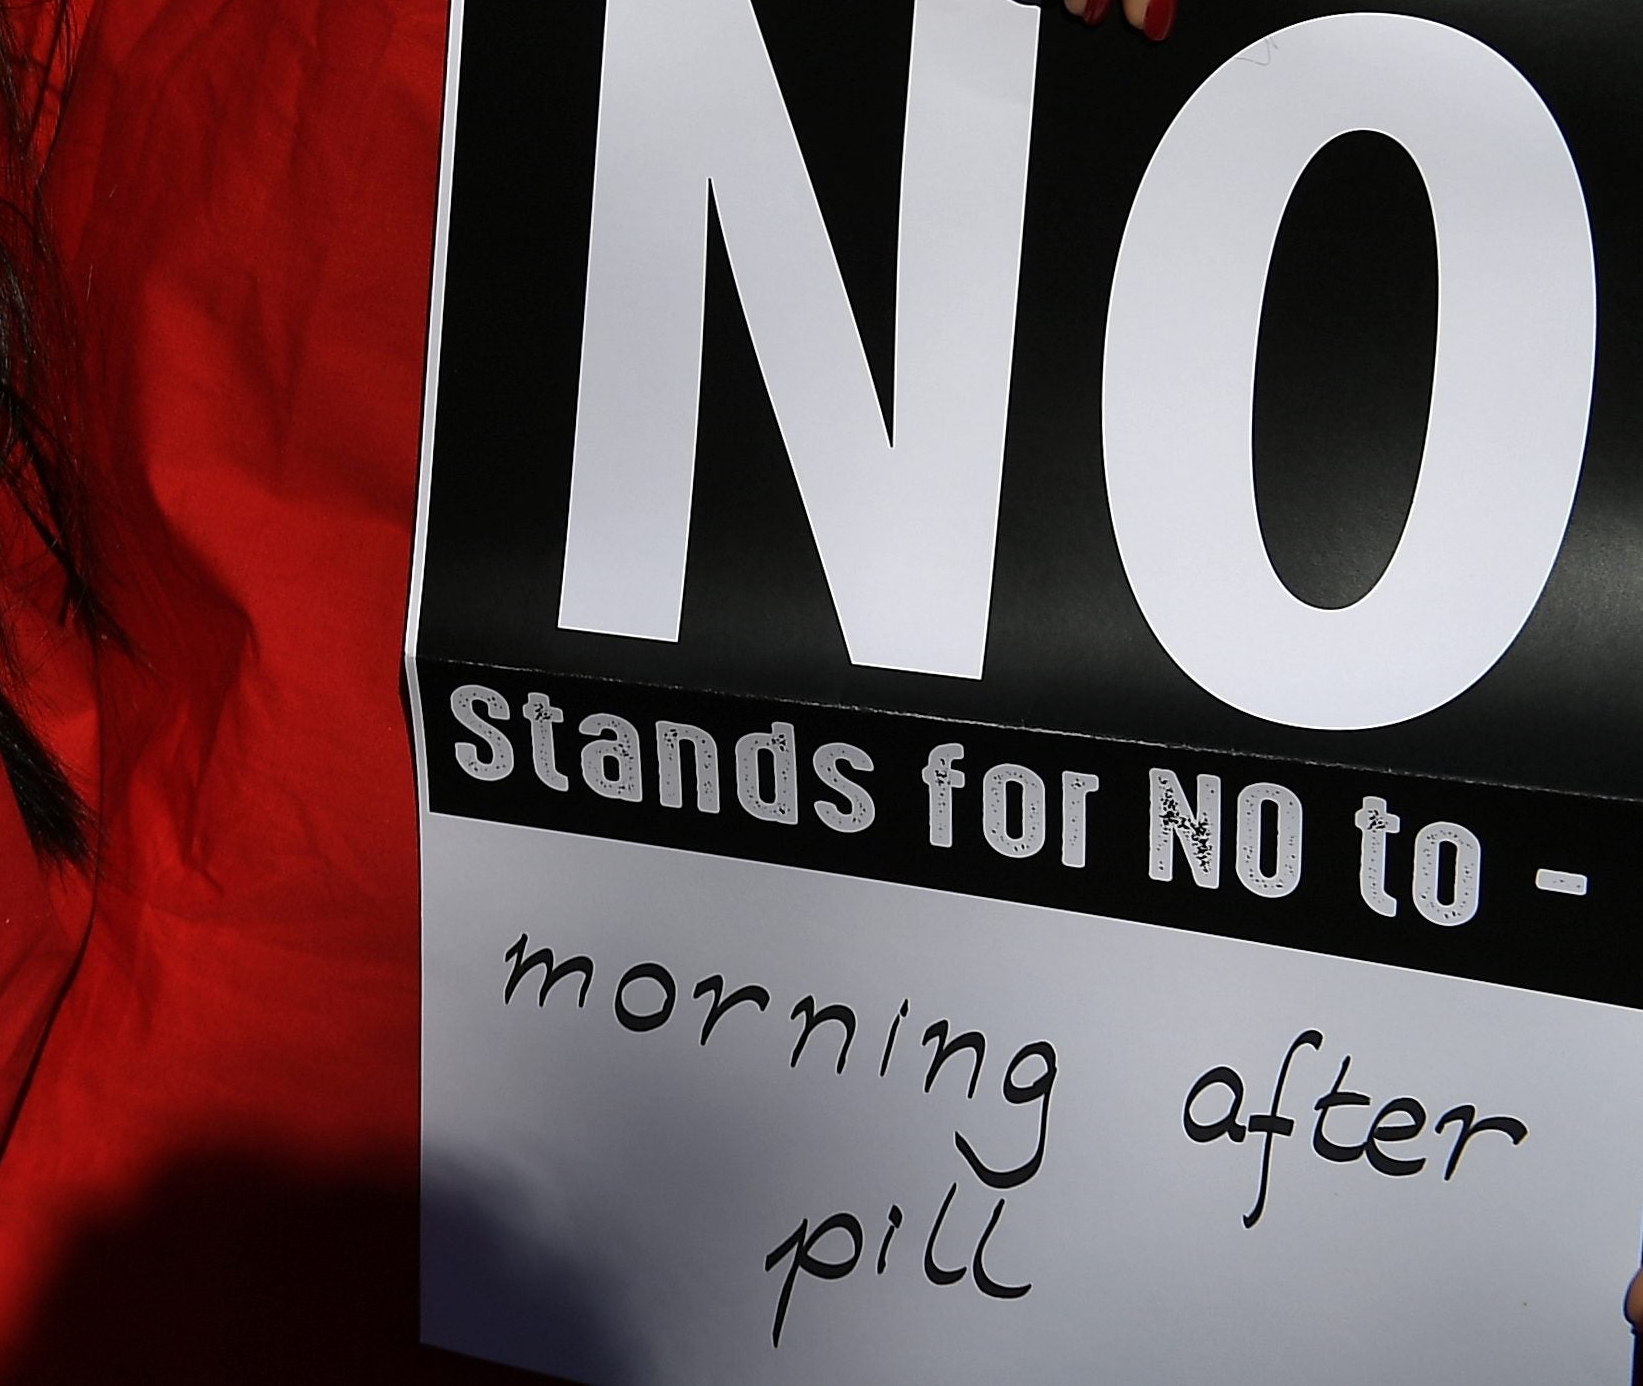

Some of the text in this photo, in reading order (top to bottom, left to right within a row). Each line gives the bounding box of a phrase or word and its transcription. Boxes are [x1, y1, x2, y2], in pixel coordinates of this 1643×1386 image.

[450, 684, 875, 832] Stands
[921, 743, 1099, 868] for
[1149, 768, 1303, 897] NO
[1355, 795, 1482, 925] to
[503, 933, 1528, 1229] morning after
[765, 1183, 1033, 1347] pill
